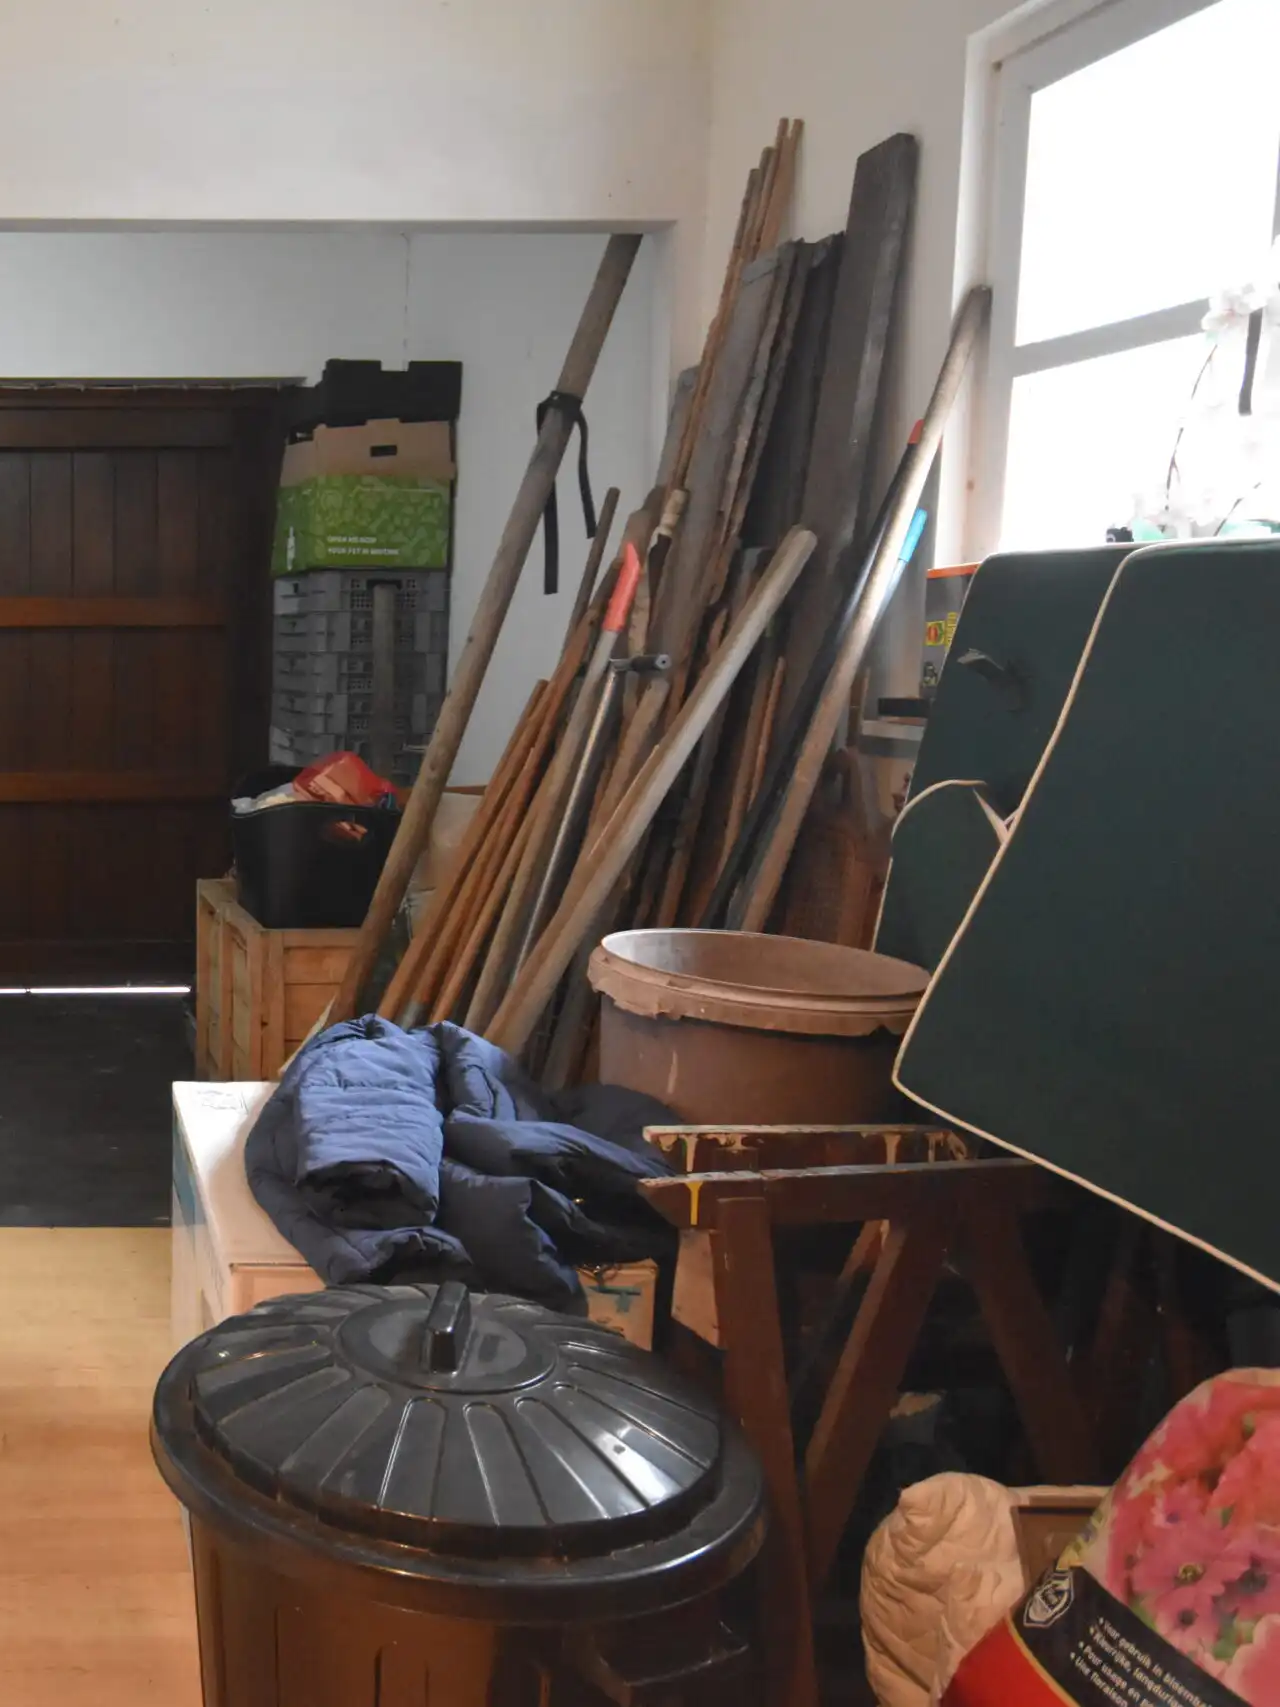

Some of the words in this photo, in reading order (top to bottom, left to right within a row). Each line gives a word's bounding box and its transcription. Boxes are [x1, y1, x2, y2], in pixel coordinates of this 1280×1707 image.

[1074, 1656, 1092, 1676] Une
[1083, 1645, 1104, 1667] Pour
[1101, 1664, 1128, 1690] usage
[1127, 1687, 1141, 1702] en
[1119, 1638, 1152, 1669] gebruik
[1152, 1664, 1164, 1678] in
[1163, 1672, 1213, 1707] bloemb
